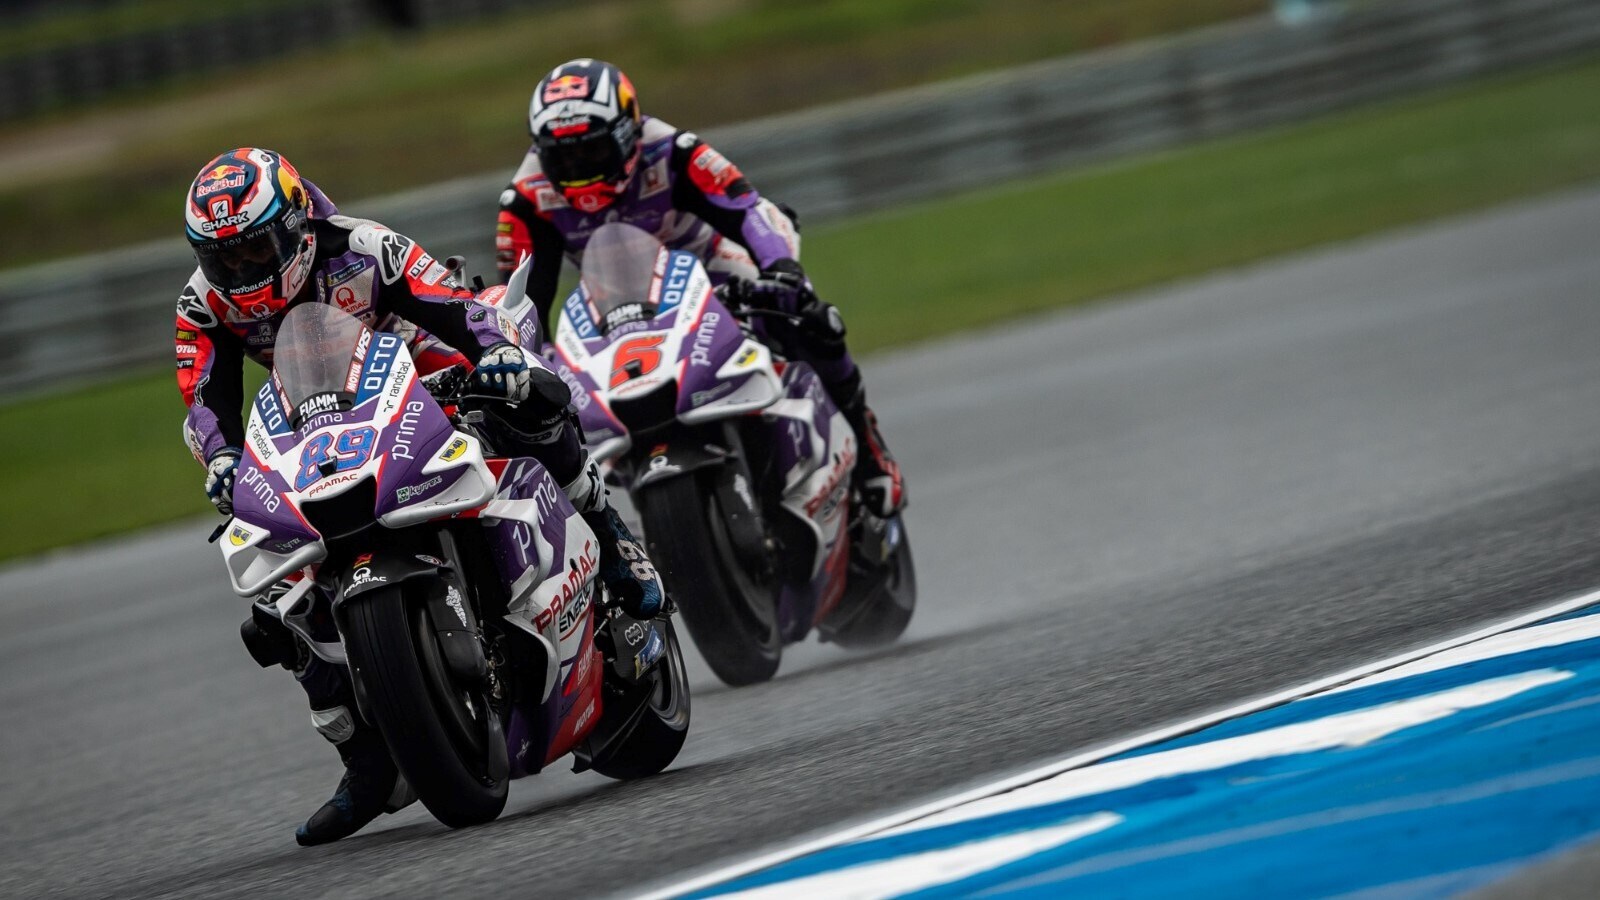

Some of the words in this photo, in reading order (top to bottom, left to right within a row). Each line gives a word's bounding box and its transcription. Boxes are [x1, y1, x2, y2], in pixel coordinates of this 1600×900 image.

[196, 185, 219, 198] Red
[220, 175, 245, 187] Bull
[201, 211, 250, 232] SHARK
[223, 238, 242, 247] YOU
[245, 222, 276, 239] WINGS
[409, 254, 430, 277] OCT
[663, 255, 693, 304] OCTO
[566, 292, 593, 337] OCTO
[176, 344, 198, 354] OTUL
[690, 312, 720, 367] prima
[364, 335, 397, 390] OCTO
[347, 363, 362, 392] MOTUL
[390, 361, 411, 399] randstad
[258, 383, 283, 431] OCTO
[299, 393, 338, 417] FIAMM
[300, 412, 343, 438] prima
[391, 401, 425, 461] prima
[252, 430, 272, 460] randstad
[294, 425, 378, 493] 89
[442, 440, 464, 459] WD-40
[239, 466, 281, 514] prima
[308, 473, 358, 498] PRAMAC
[343, 576, 387, 597] PRAMAC
[533, 540, 597, 635] PRAMAC
